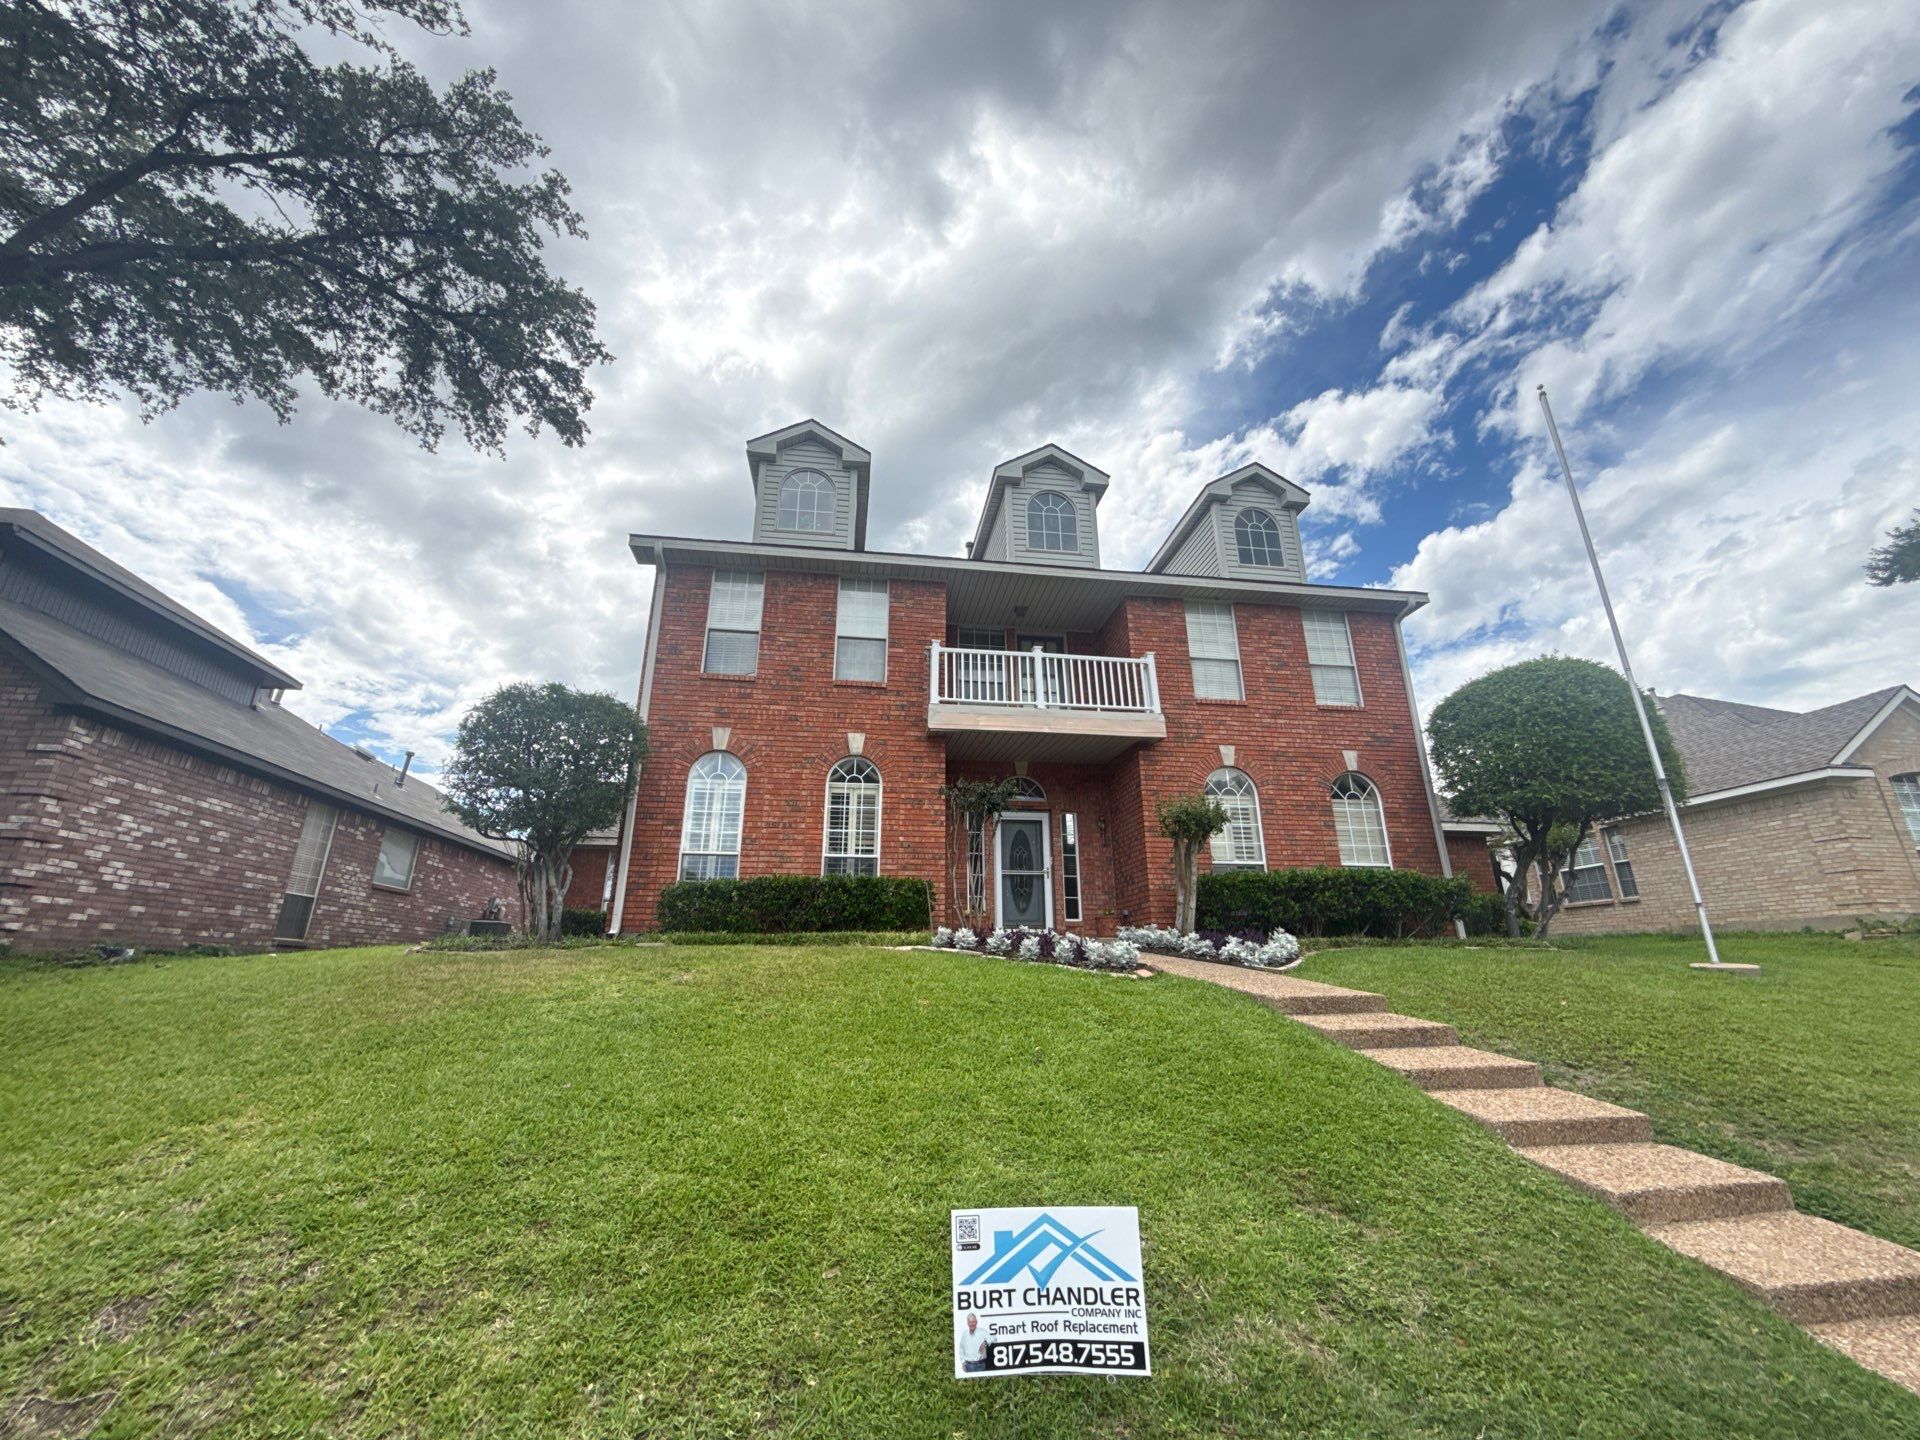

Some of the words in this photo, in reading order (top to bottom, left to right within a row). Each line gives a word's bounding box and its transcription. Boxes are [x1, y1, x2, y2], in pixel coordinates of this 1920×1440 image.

[957, 1289, 1016, 1310] BURT
[1023, 1287, 1141, 1307] CHANDLER
[1071, 1308, 1121, 1318] COMPANY
[1124, 1309, 1142, 1319] INC
[989, 1322, 1026, 1335] Smart
[1031, 1320, 1059, 1333] Roof
[1063, 1320, 1139, 1335] Replacement
[993, 1342, 1135, 1367] 817.548.7555
